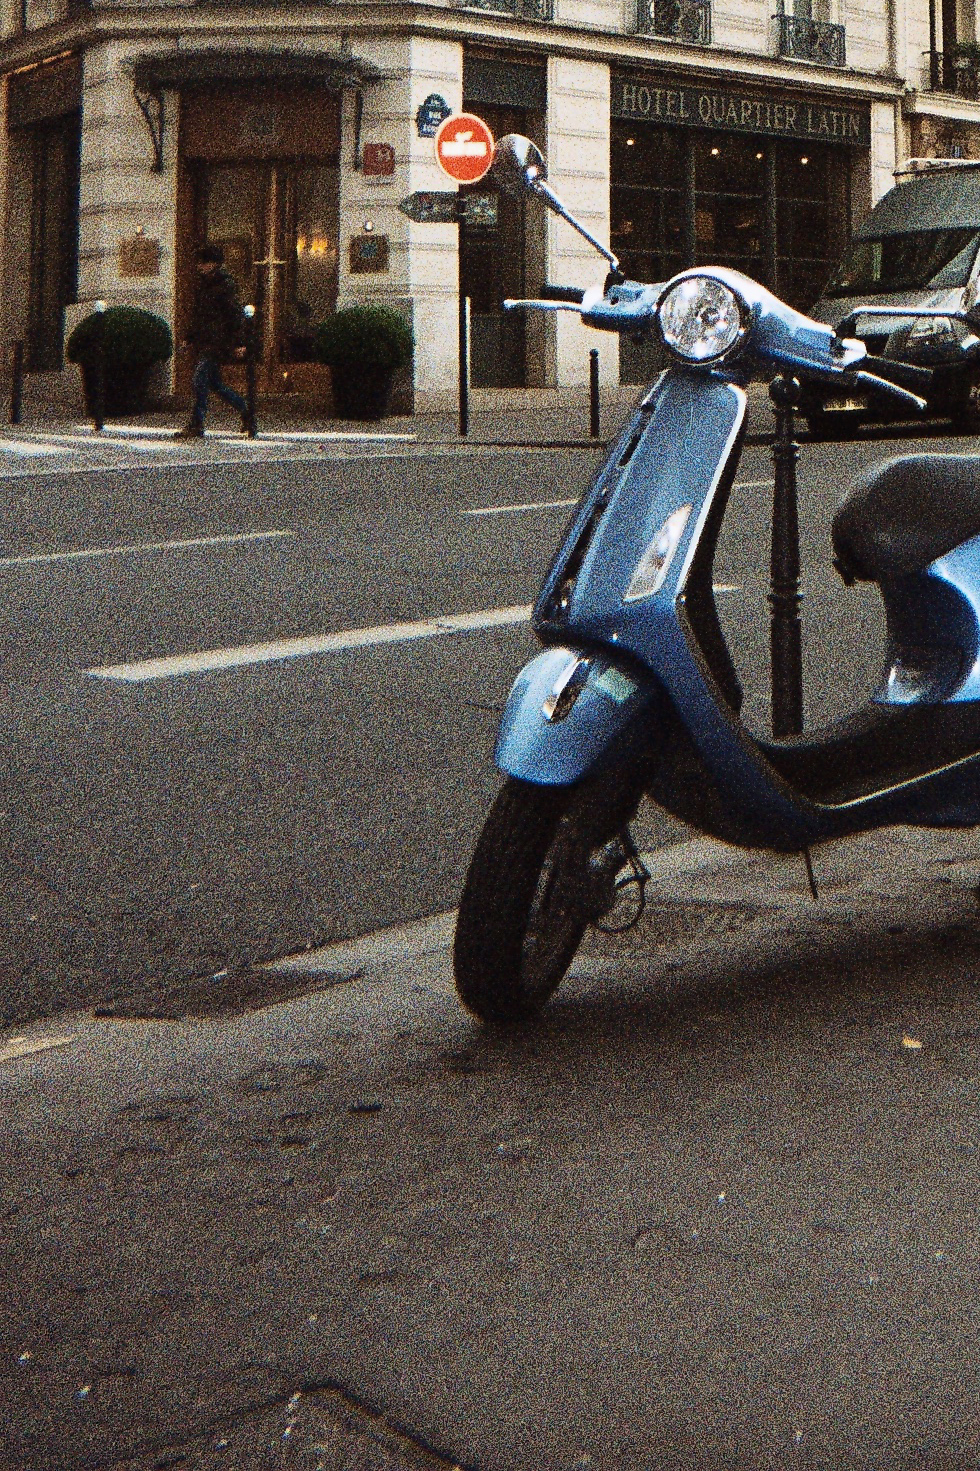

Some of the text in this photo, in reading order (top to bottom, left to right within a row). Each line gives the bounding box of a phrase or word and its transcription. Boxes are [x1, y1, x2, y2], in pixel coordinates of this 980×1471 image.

[621, 85, 859, 136] HOTEL QUARTIER LATIN
